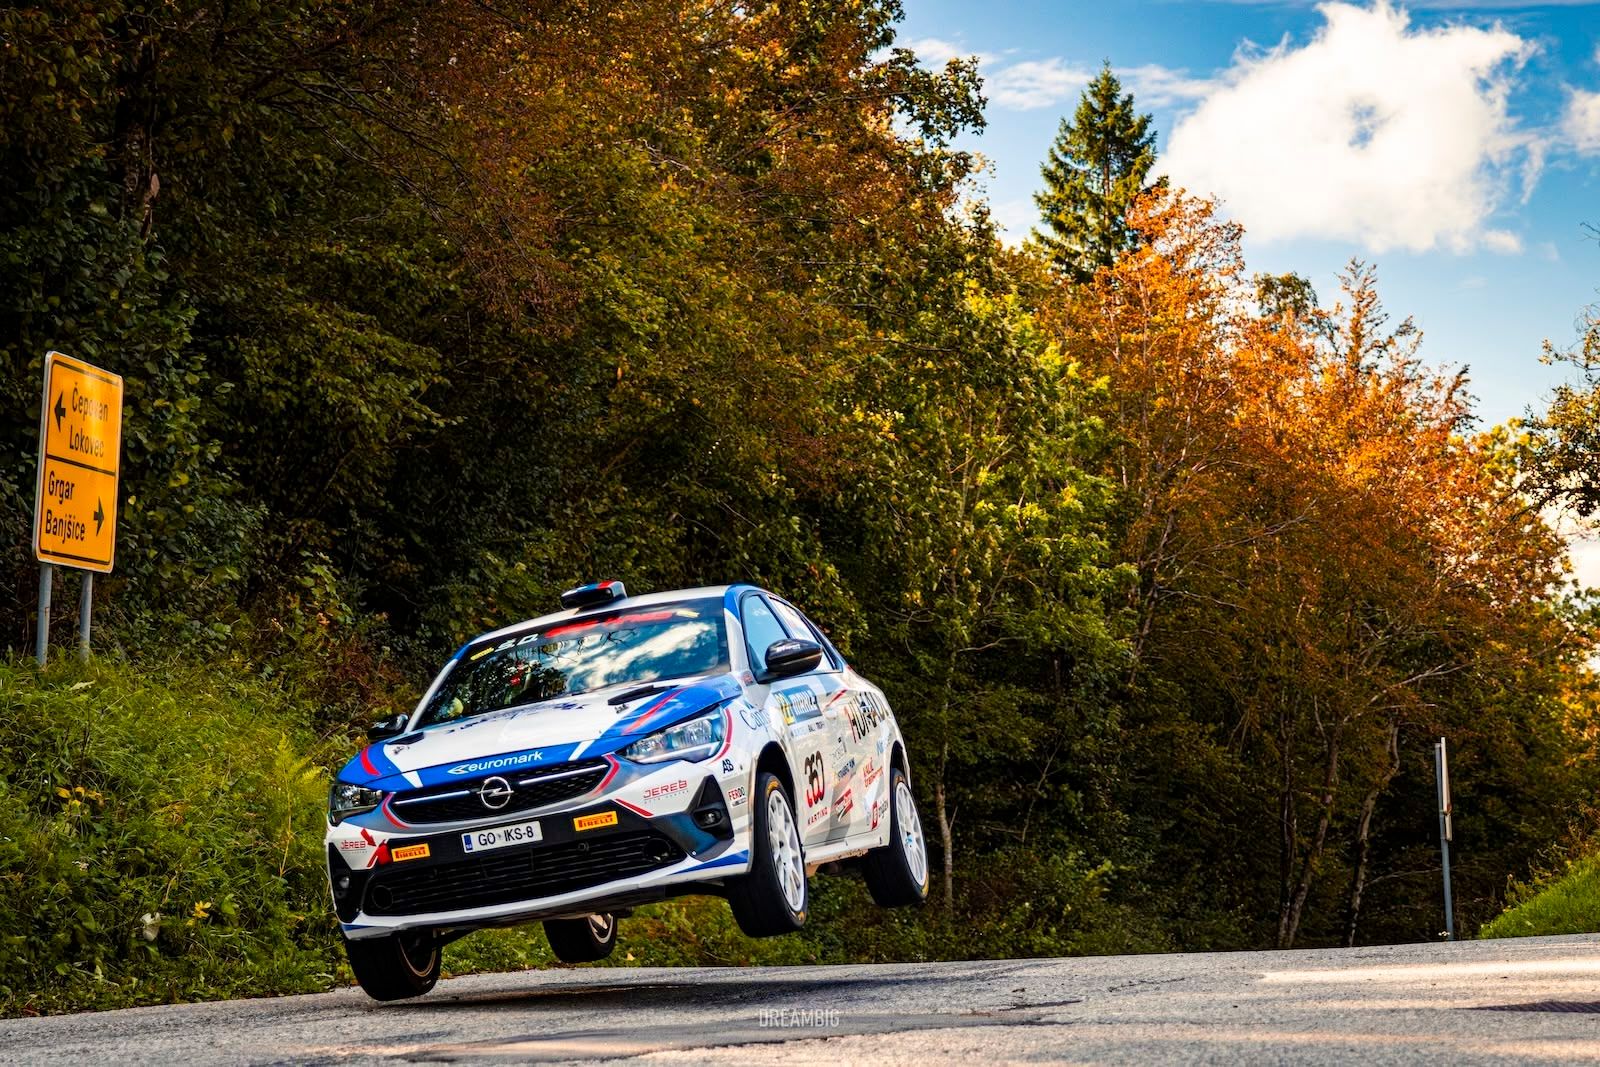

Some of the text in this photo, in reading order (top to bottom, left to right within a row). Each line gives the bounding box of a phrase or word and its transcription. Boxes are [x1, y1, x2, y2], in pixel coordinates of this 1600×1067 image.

[69, 424, 105, 458] Lokovec
[48, 470, 75, 505] Grgar
[45, 509, 85, 544] Banjšice
[468, 751, 543, 772] euromark
[643, 780, 687, 799] JEREB
[578, 814, 613, 828] PIRELLI
[478, 825, 534, 846] GO IKS-8
[395, 846, 426, 859] PIRELLI
